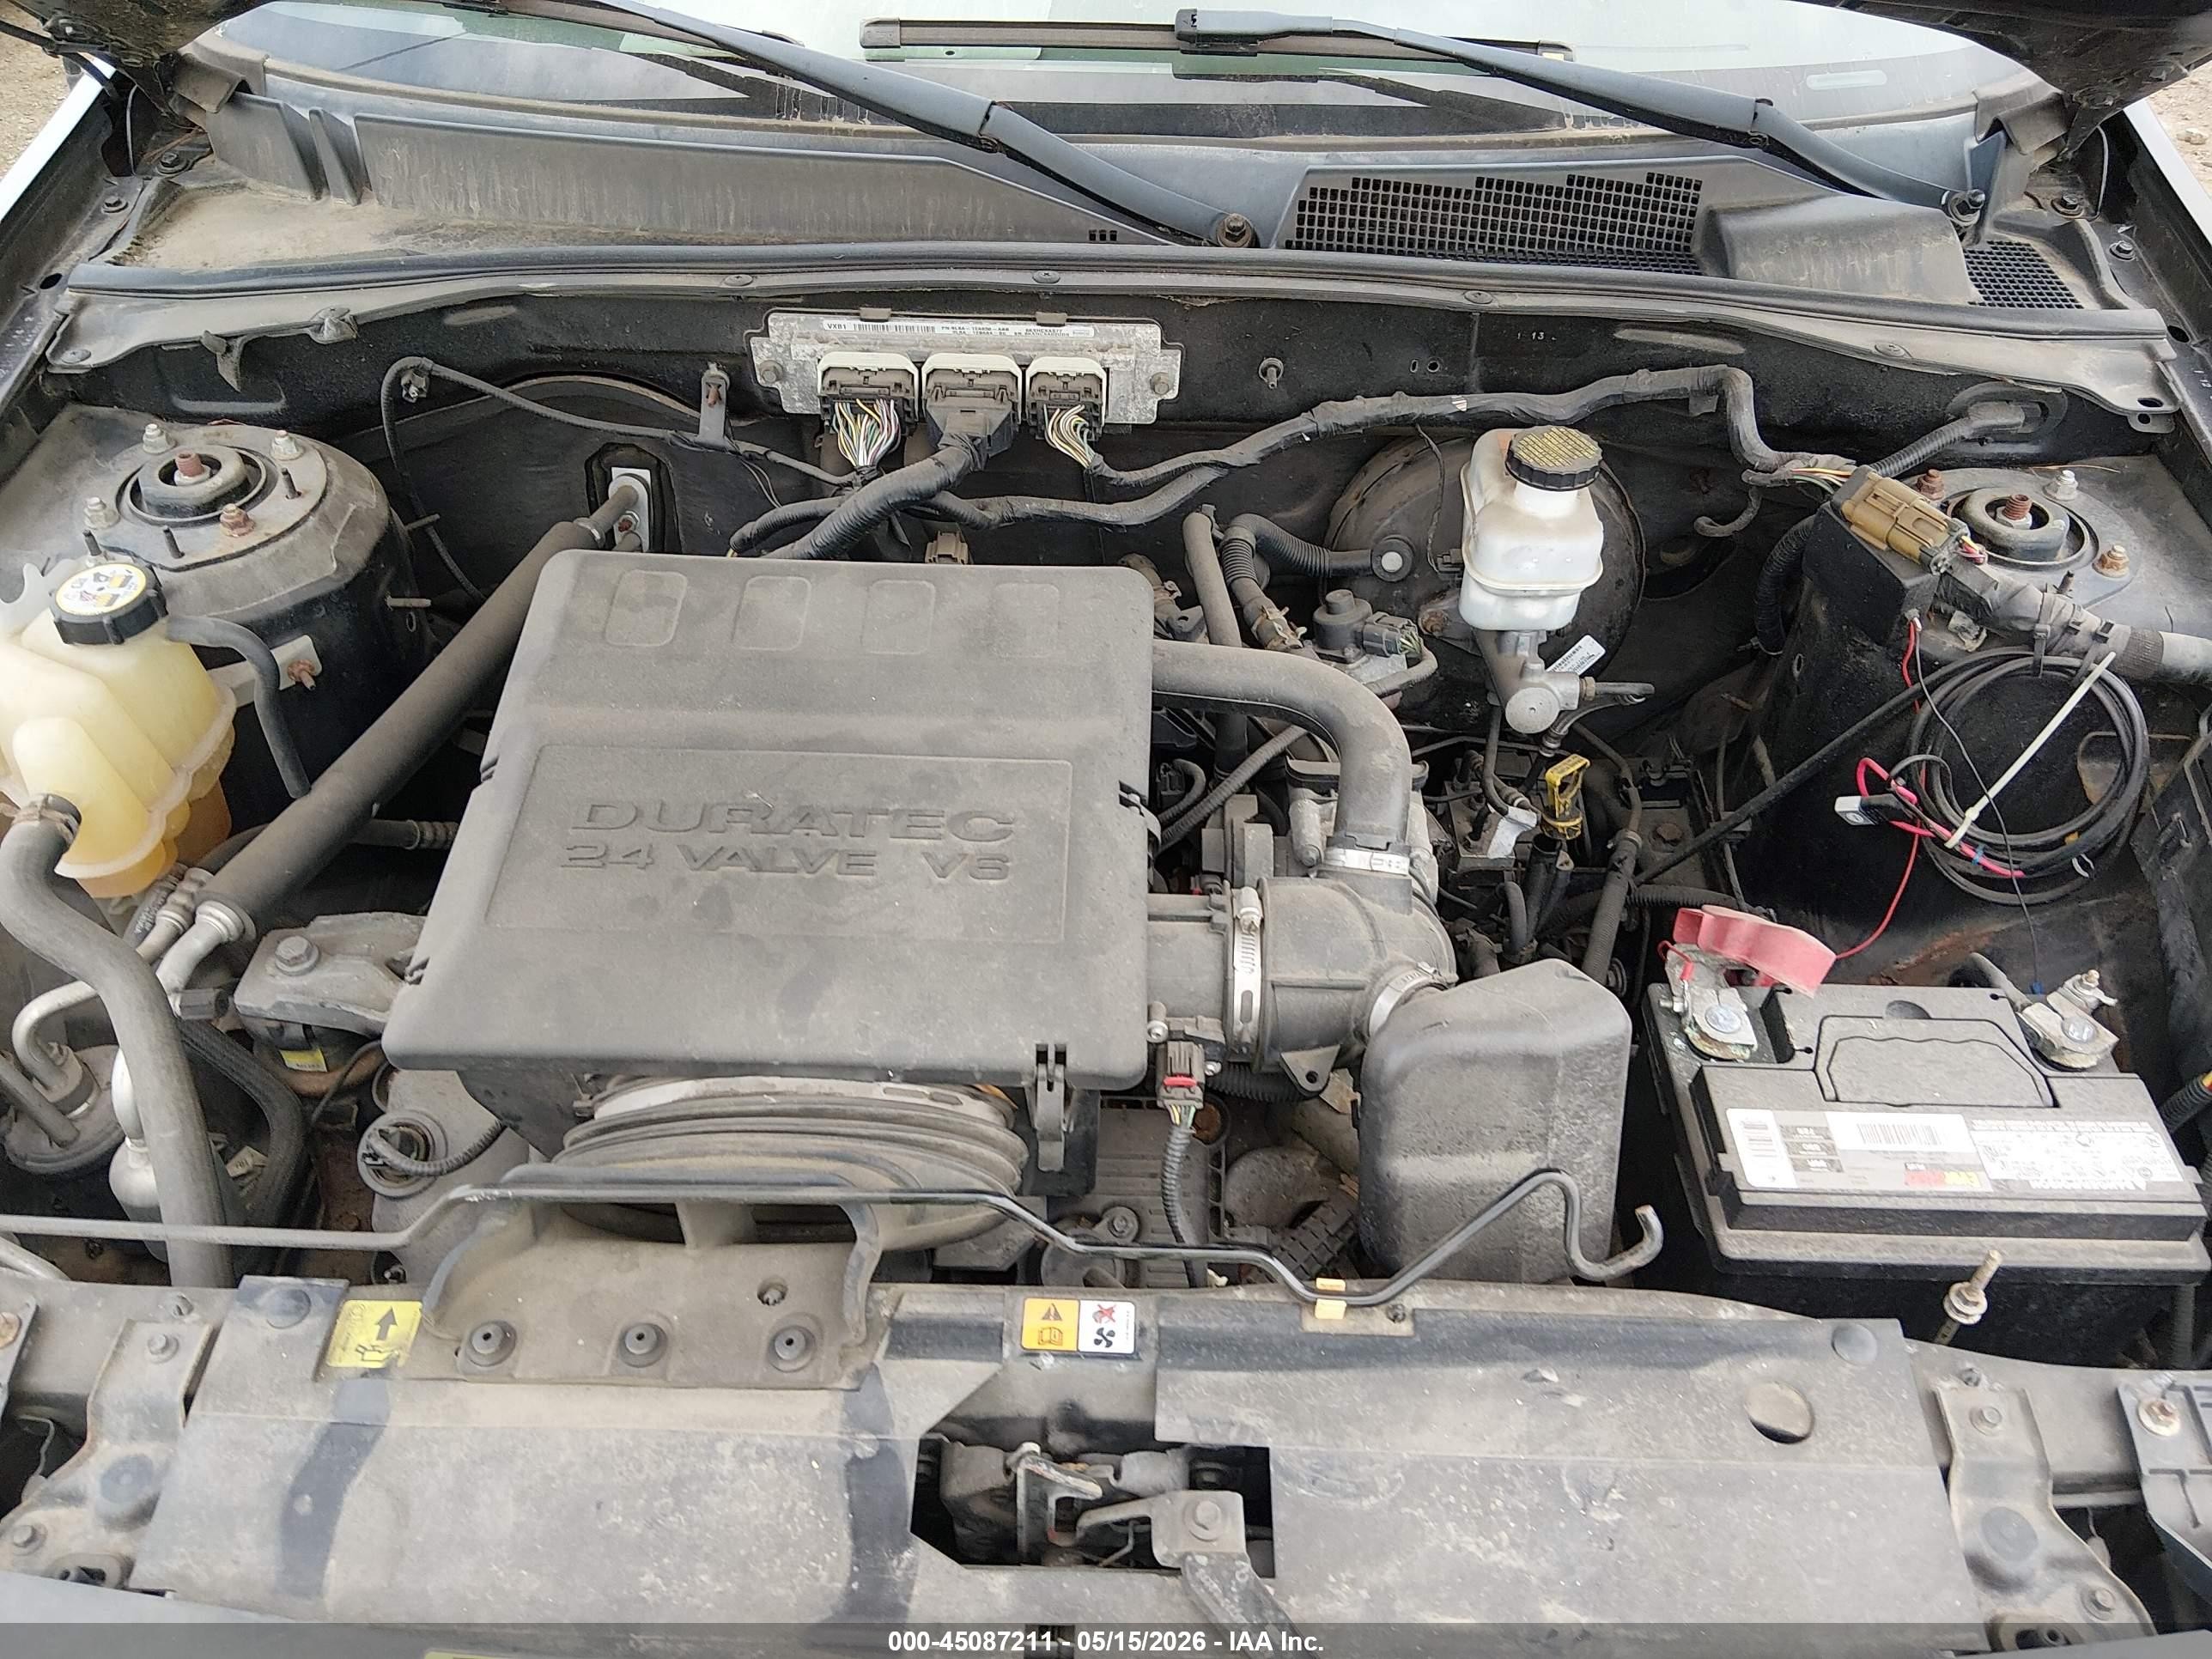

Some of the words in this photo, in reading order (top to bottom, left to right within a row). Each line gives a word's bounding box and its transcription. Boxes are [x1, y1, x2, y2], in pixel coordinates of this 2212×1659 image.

[570, 801, 1016, 842] DURATEC
[560, 843, 655, 870] 24
[675, 844, 878, 877] VALVE
[921, 851, 1012, 881] V6
